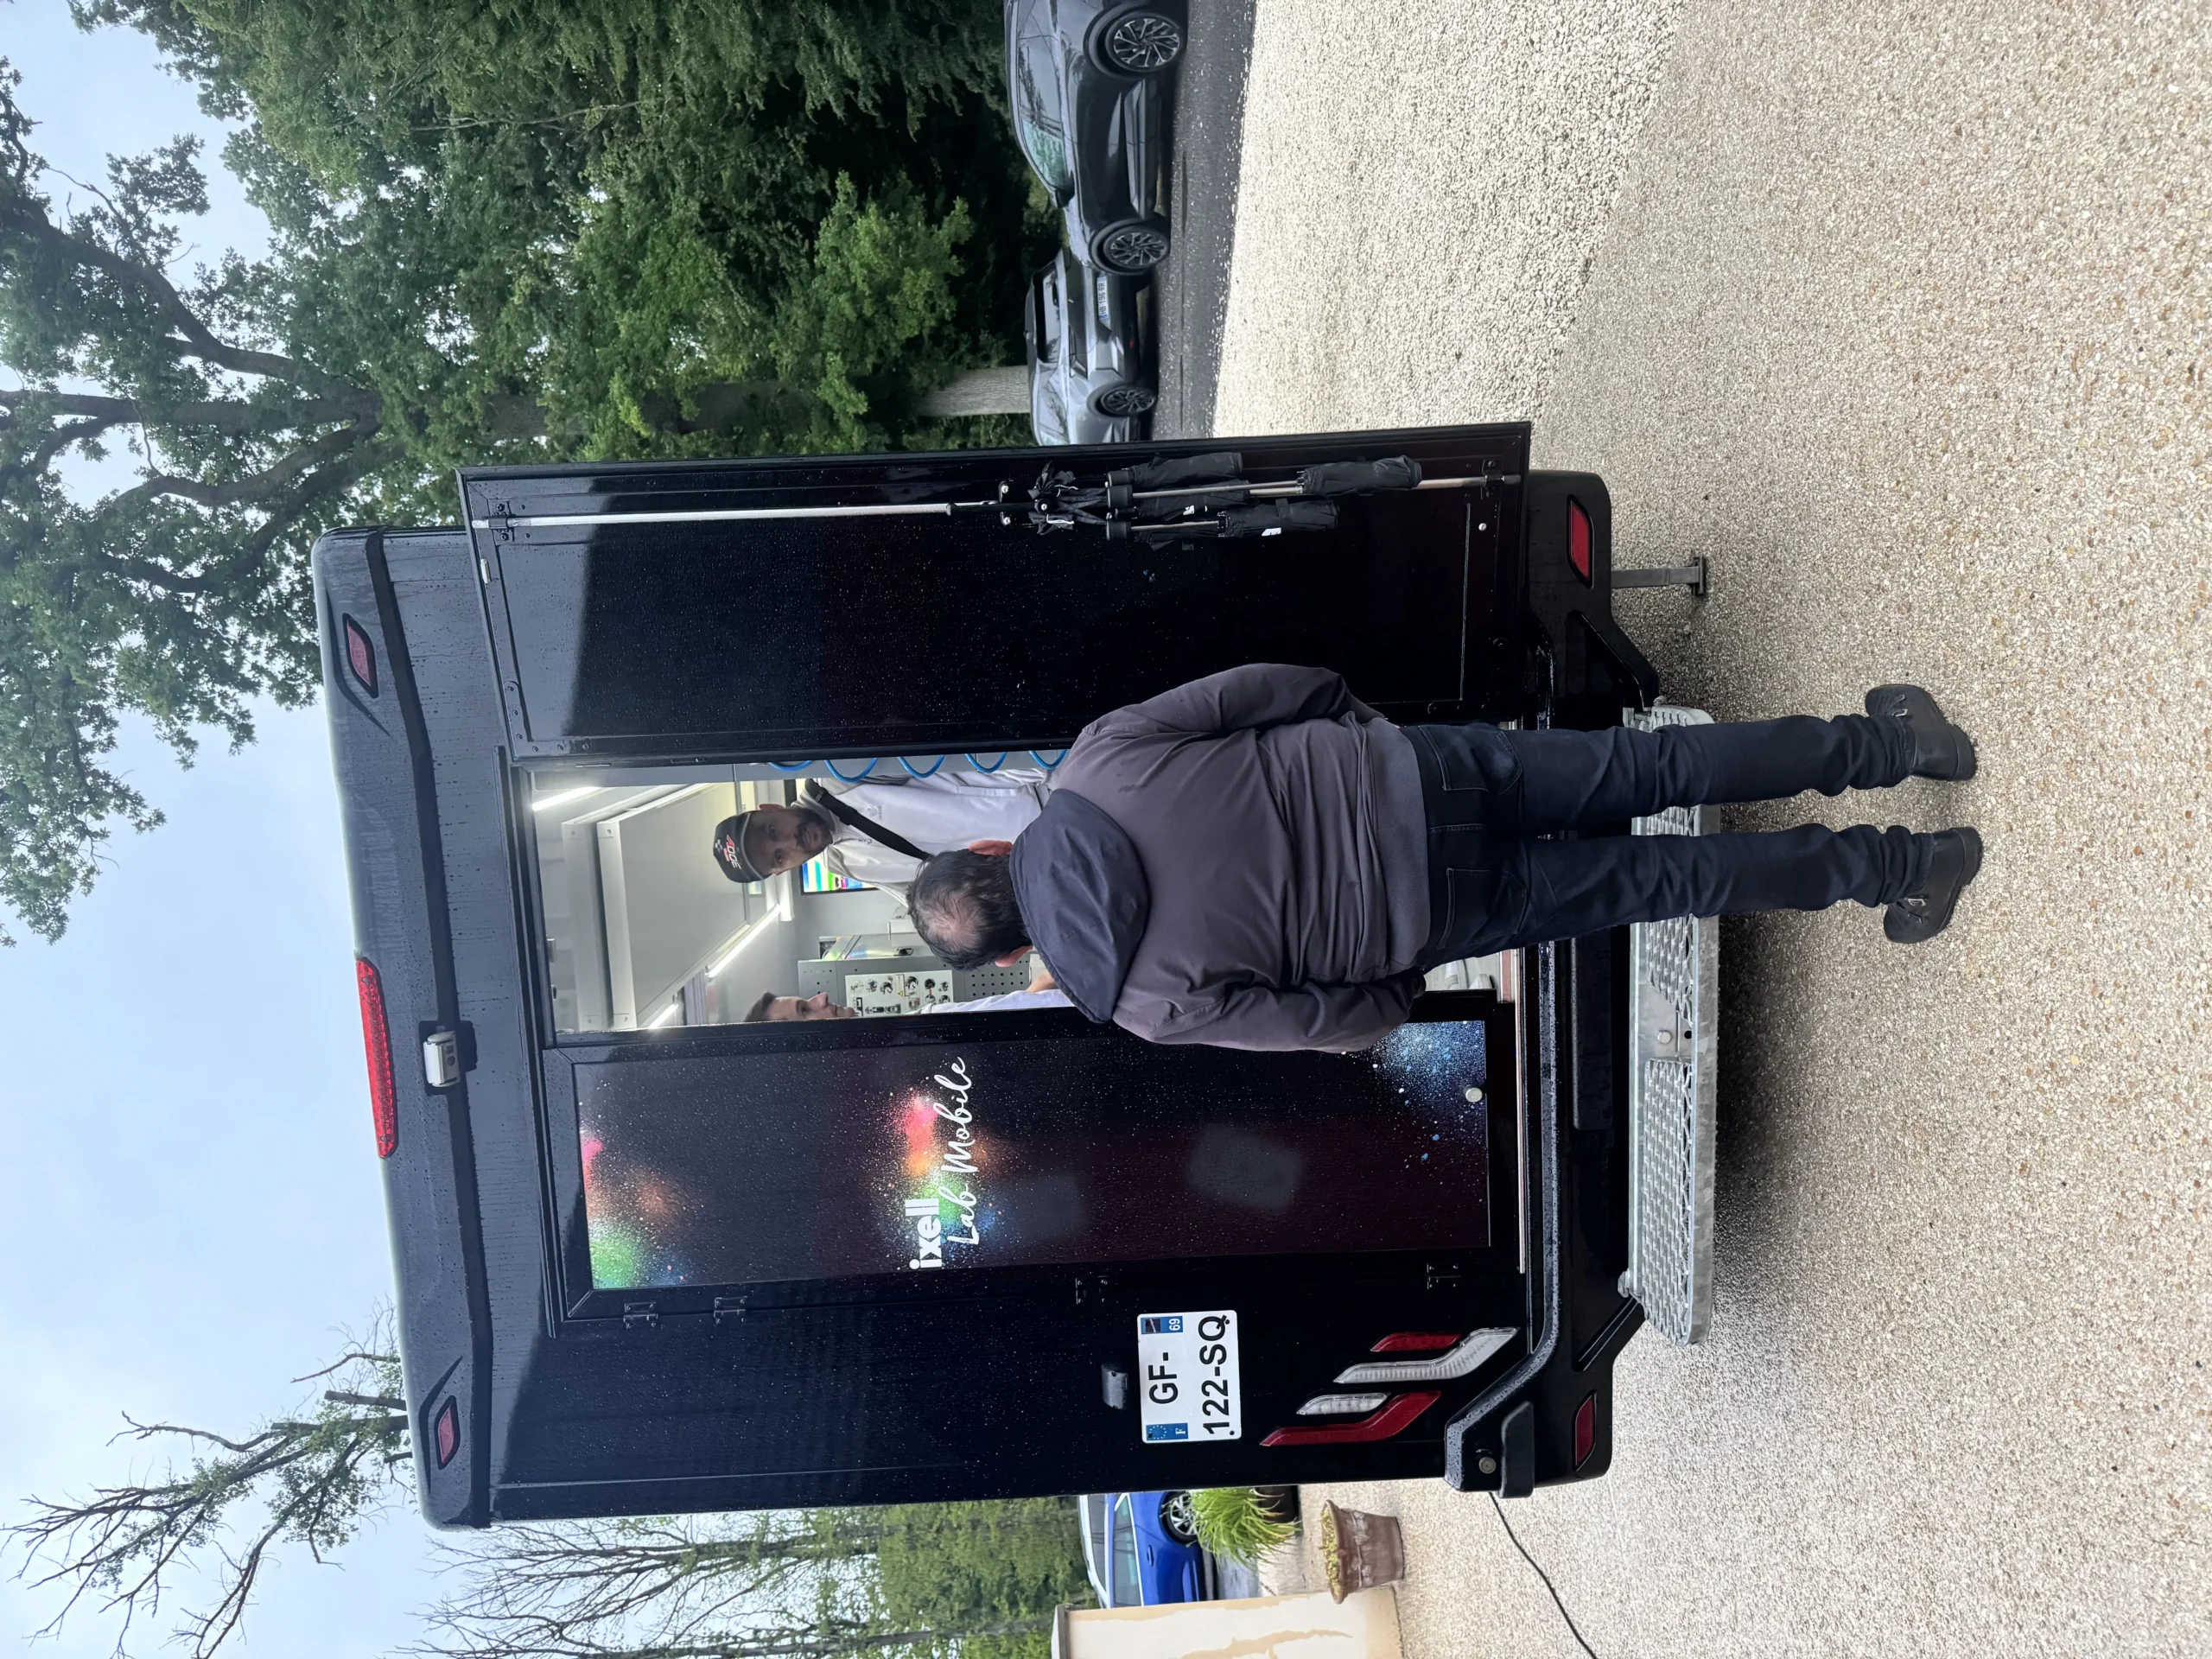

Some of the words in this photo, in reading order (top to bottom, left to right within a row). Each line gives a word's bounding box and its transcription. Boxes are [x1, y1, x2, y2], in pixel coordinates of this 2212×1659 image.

[932, 1056, 978, 1173] Mobile
[905, 1198, 942, 1270] ixell
[938, 1184, 979, 1245] Lab
[1169, 1319, 1181, 1332] 69
[1148, 1352, 1179, 1404] GF-
[1198, 1315, 1230, 1434] 122-SQ
